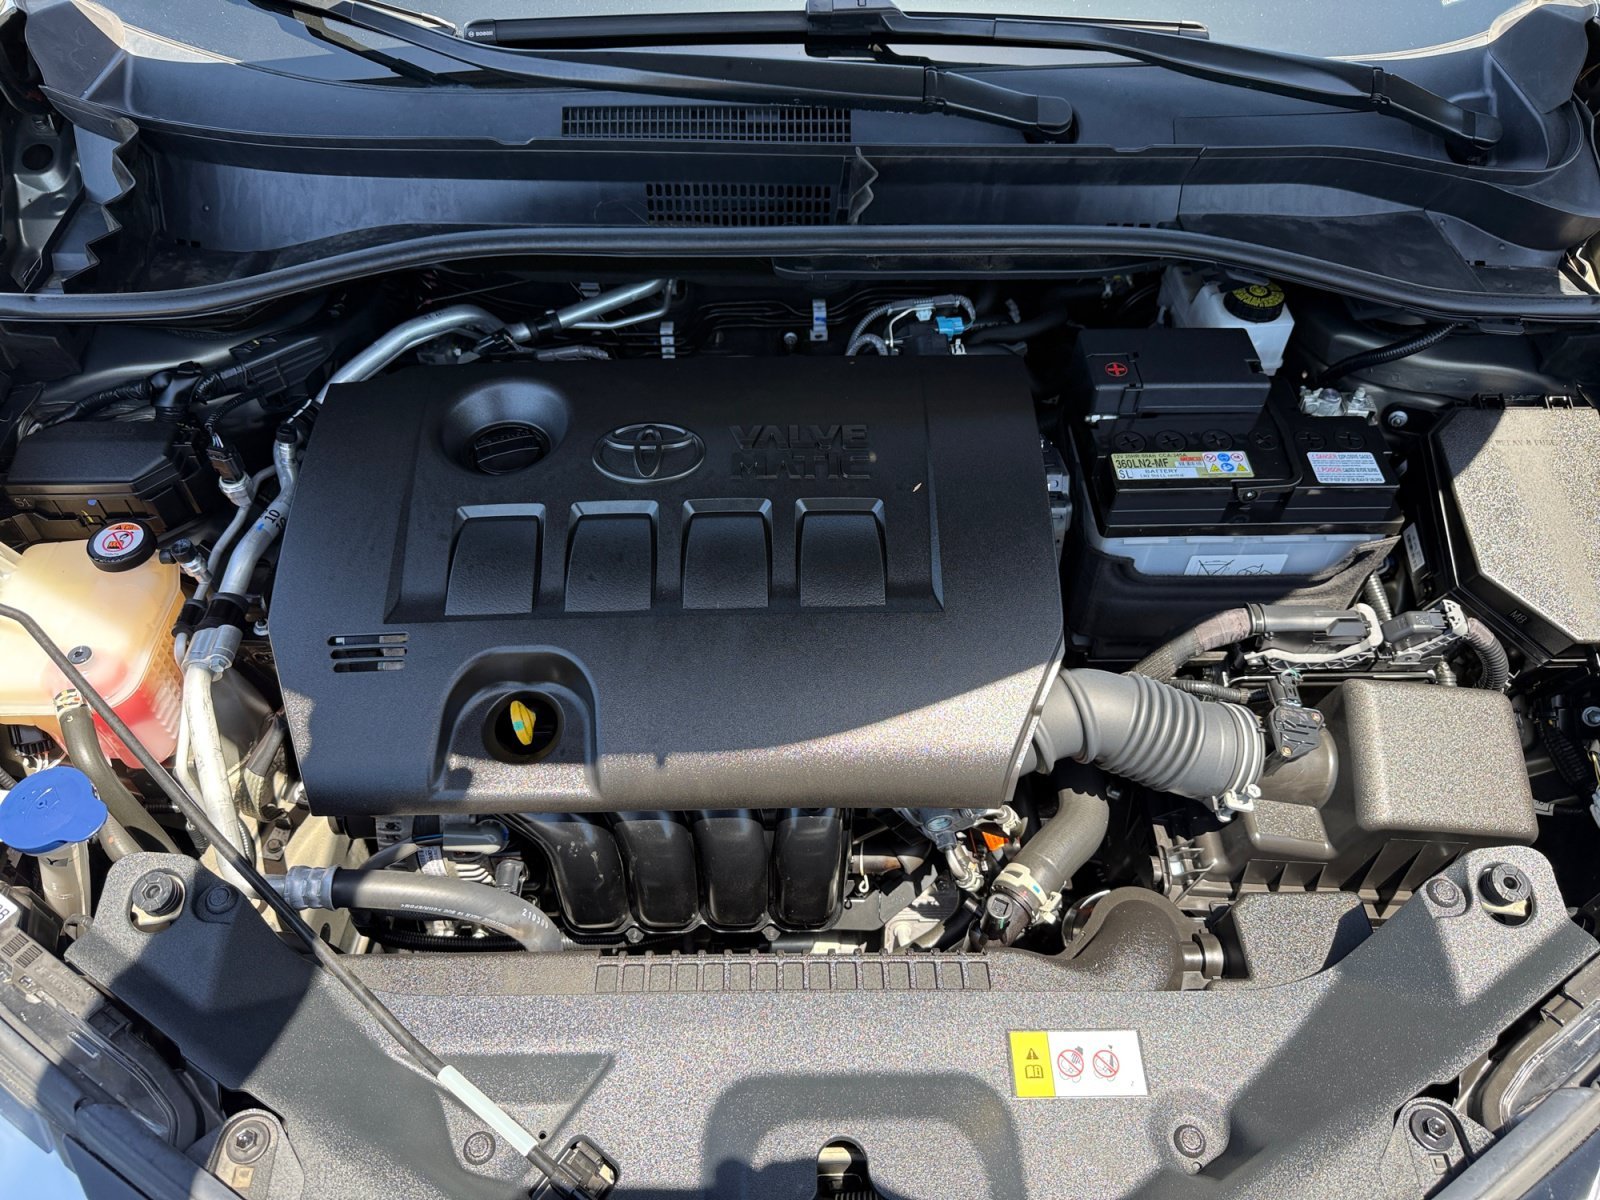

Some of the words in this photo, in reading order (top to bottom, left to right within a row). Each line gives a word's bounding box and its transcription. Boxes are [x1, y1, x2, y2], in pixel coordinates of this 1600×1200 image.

[728, 424, 868, 449] VALVE
[729, 450, 873, 480] MATIC
[1115, 457, 1169, 469] 360LN2-MF
[1119, 470, 1133, 479] SL
